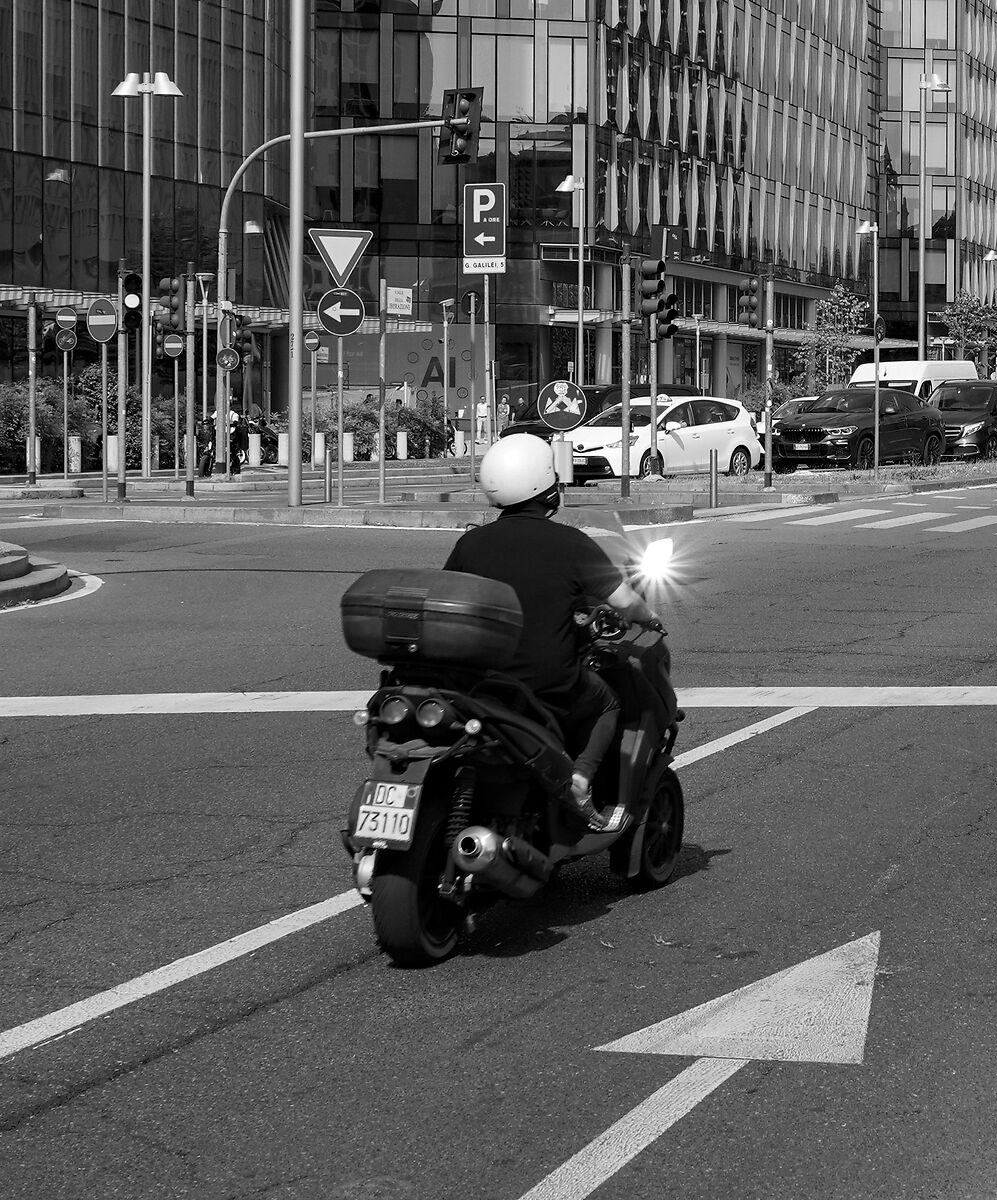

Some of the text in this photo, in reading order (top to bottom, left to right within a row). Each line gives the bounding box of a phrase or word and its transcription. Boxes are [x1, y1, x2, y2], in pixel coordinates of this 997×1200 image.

[473, 188, 496, 223] P
[420, 356, 456, 388] AI
[375, 784, 397, 806] DC
[358, 810, 410, 835] 73110
